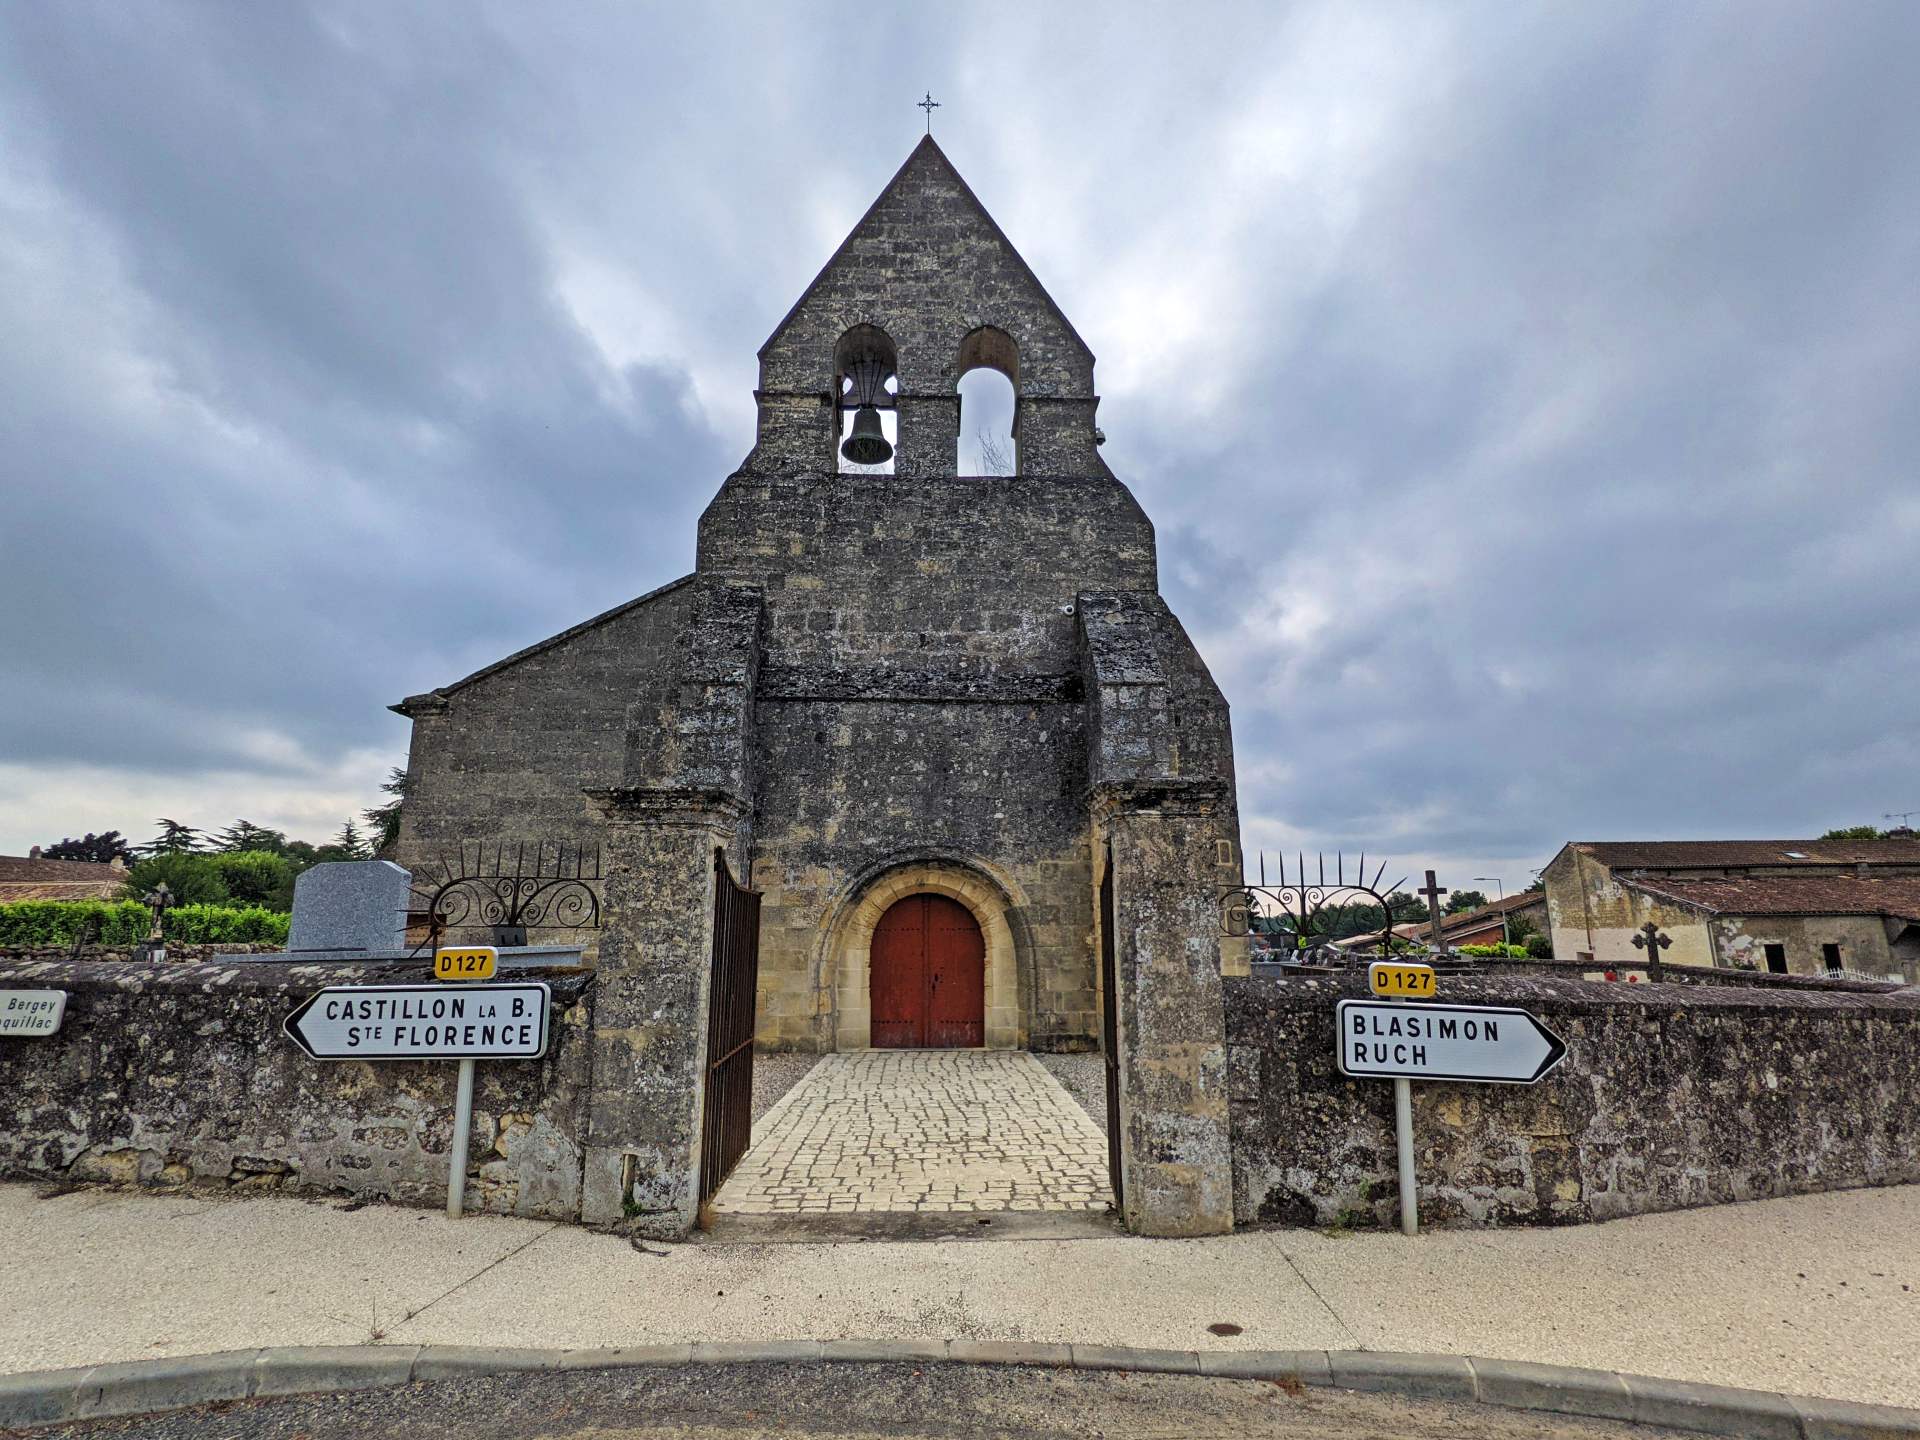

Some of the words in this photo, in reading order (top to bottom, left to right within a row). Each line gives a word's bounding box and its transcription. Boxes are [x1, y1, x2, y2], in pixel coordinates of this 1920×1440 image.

[8, 998, 56, 1014] Bergey
[326, 998, 465, 1020] CASTILLON
[478, 1004, 497, 1018] LA
[511, 997, 533, 1018] B.
[0, 1015, 52, 1031] quillac
[1353, 1014, 1499, 1041] BLASIMON
[347, 1026, 383, 1047] STE
[393, 1024, 533, 1047] FLORENCE
[1354, 1042, 1427, 1066] RUCH
